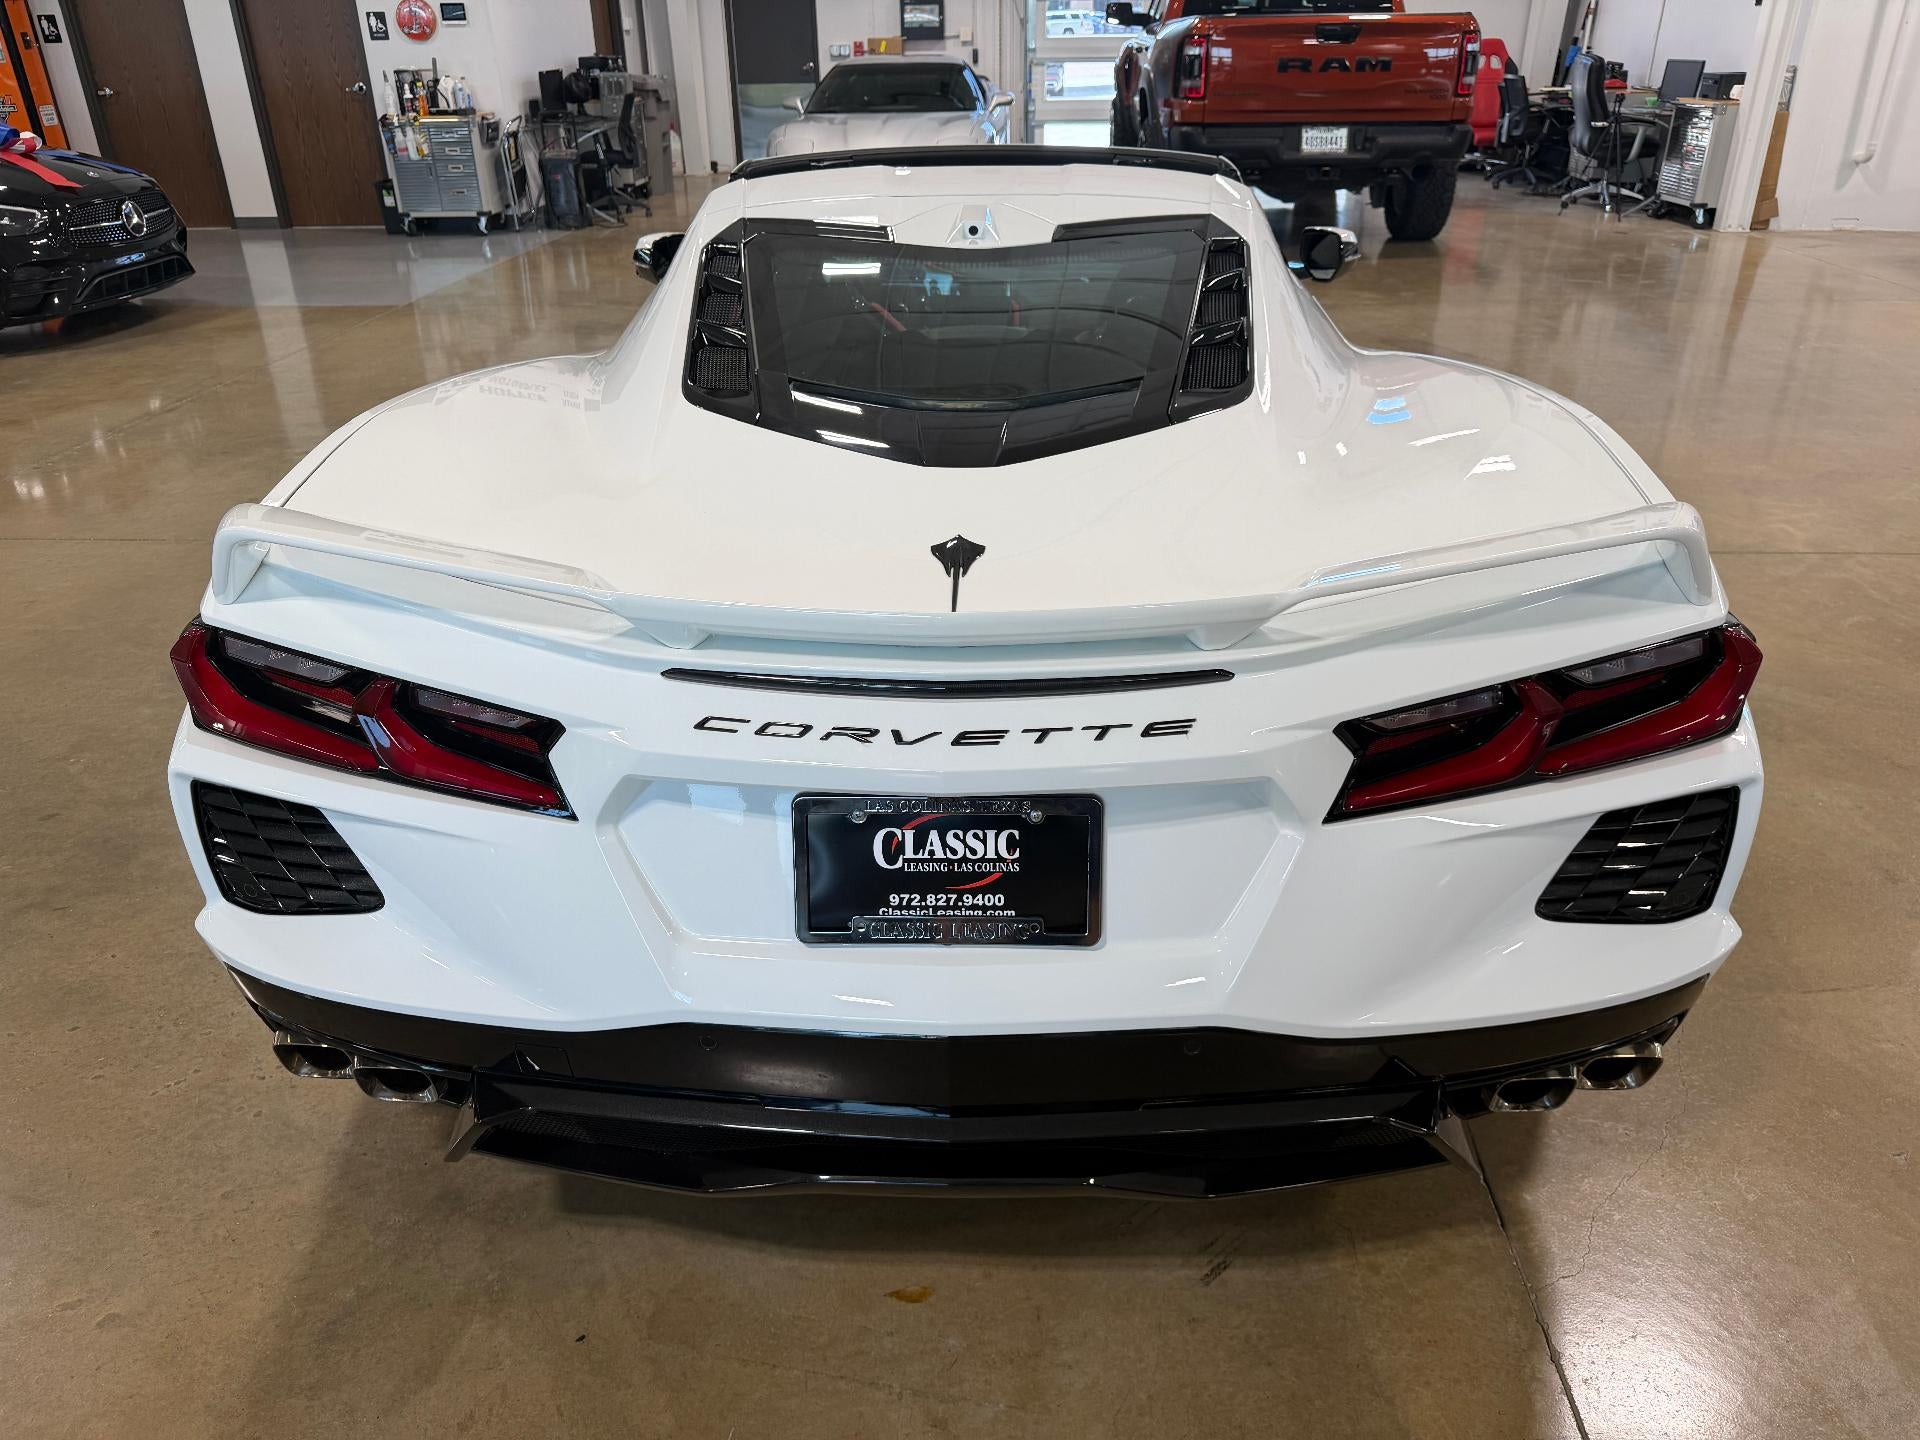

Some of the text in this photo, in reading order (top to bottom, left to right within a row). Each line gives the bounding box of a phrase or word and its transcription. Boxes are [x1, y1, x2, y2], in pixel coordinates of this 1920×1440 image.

[1277, 56, 1393, 73] RAM
[694, 715, 1197, 747] CORVETTE
[864, 800, 894, 812] LAS
[978, 800, 1031, 813] TEXAS
[873, 828, 1020, 869] CLASSIC
[904, 862, 1020, 872] LEASING LAS COLINAS
[889, 893, 1005, 906] 972.827.9400
[878, 907, 1016, 917] ClassicLeasing.com
[870, 922, 1029, 939] CLASSIC LEASING
